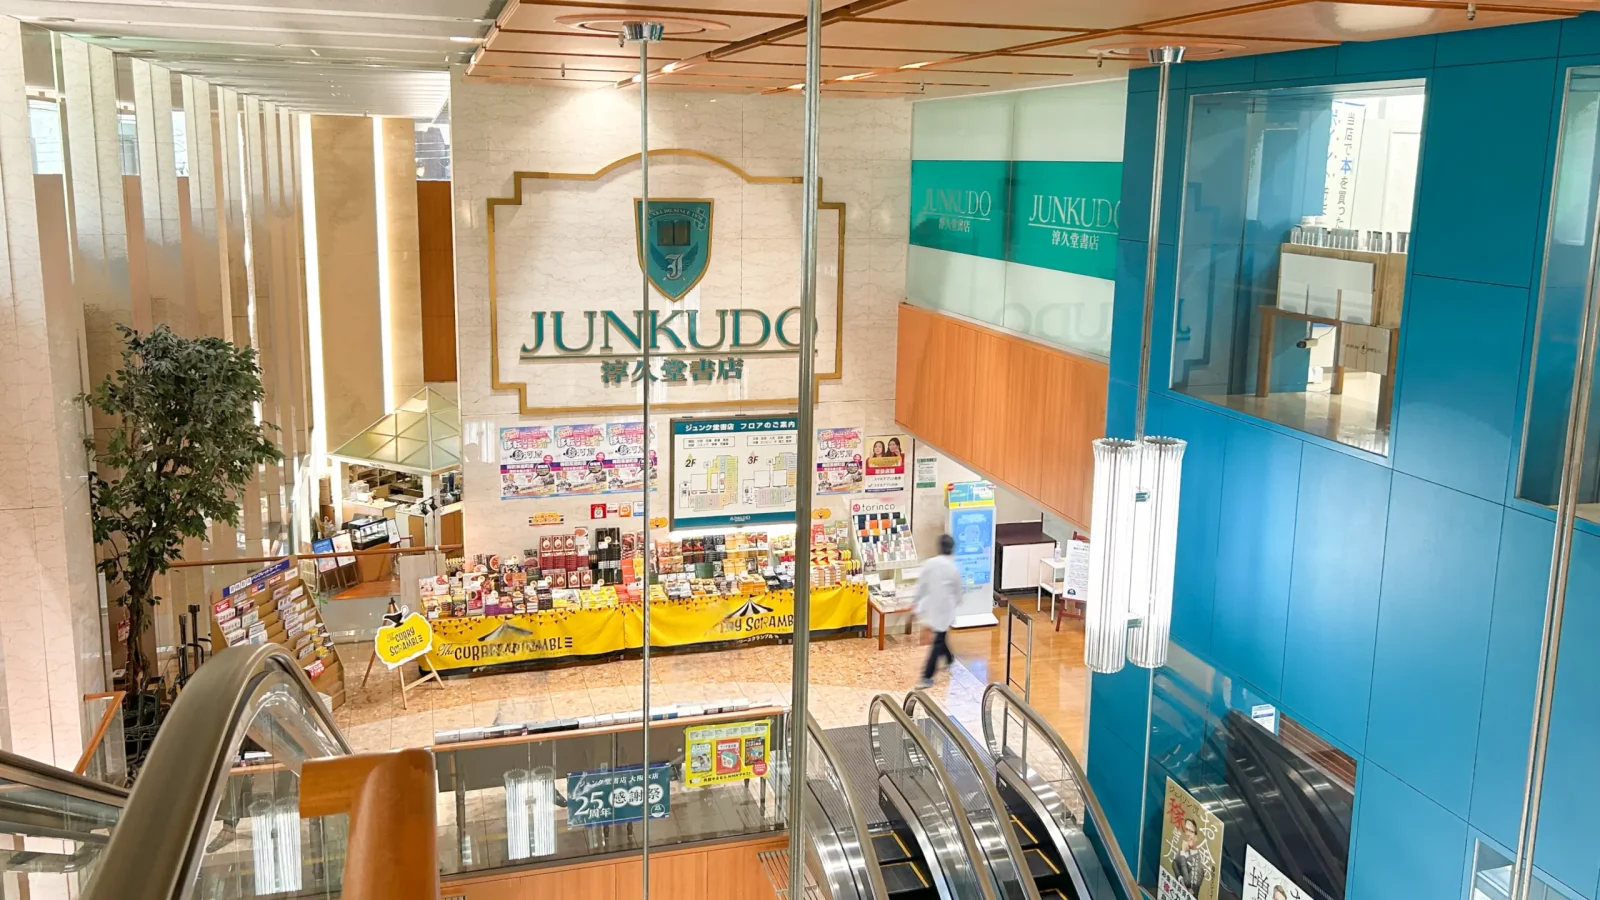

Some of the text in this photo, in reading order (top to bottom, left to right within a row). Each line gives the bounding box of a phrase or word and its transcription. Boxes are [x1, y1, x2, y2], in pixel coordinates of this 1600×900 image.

[922, 187, 992, 217] JUNKUDO
[1051, 229, 1100, 251] 淳久堂書店
[520, 306, 818, 353] JUNKUDO
[601, 358, 744, 386] 淳久堂書店
[685, 421, 796, 432] ジュンク堂書店 フロアのご案内
[685, 458, 697, 468] 2F
[747, 455, 759, 465] 3F
[862, 502, 901, 512] torinco
[745, 614, 794, 631] SCRAMB
[394, 626, 416, 643] CURRY
[436, 642, 455, 656] The
[579, 776, 627, 788] ジュンク堂書店
[574, 787, 660, 819] 25 周年 感謝祭
